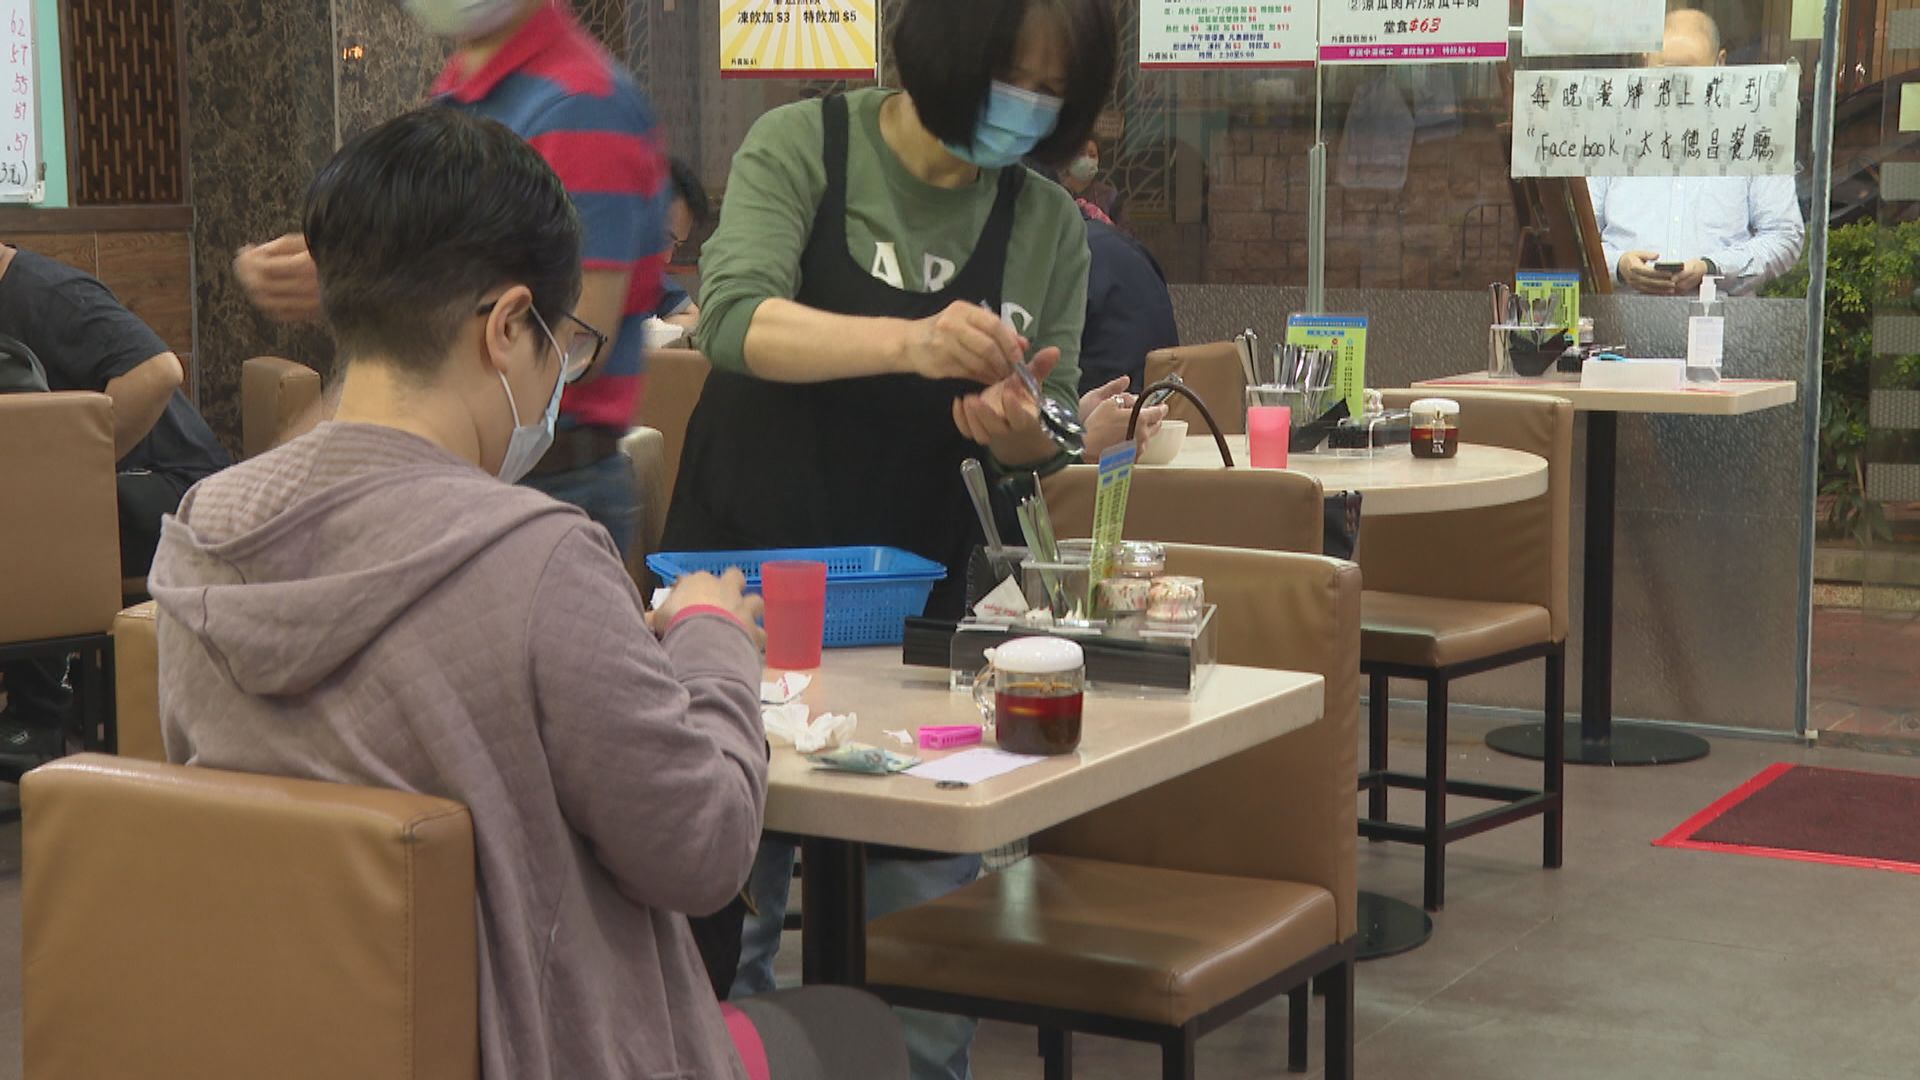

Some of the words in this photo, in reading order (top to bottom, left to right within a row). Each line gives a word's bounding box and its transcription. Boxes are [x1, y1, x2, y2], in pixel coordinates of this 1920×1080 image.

[10, 8, 26, 37] 62
[776, 11, 791, 23] $3
[803, 10, 840, 24] 特飲加
[842, 10, 857, 22] $5
